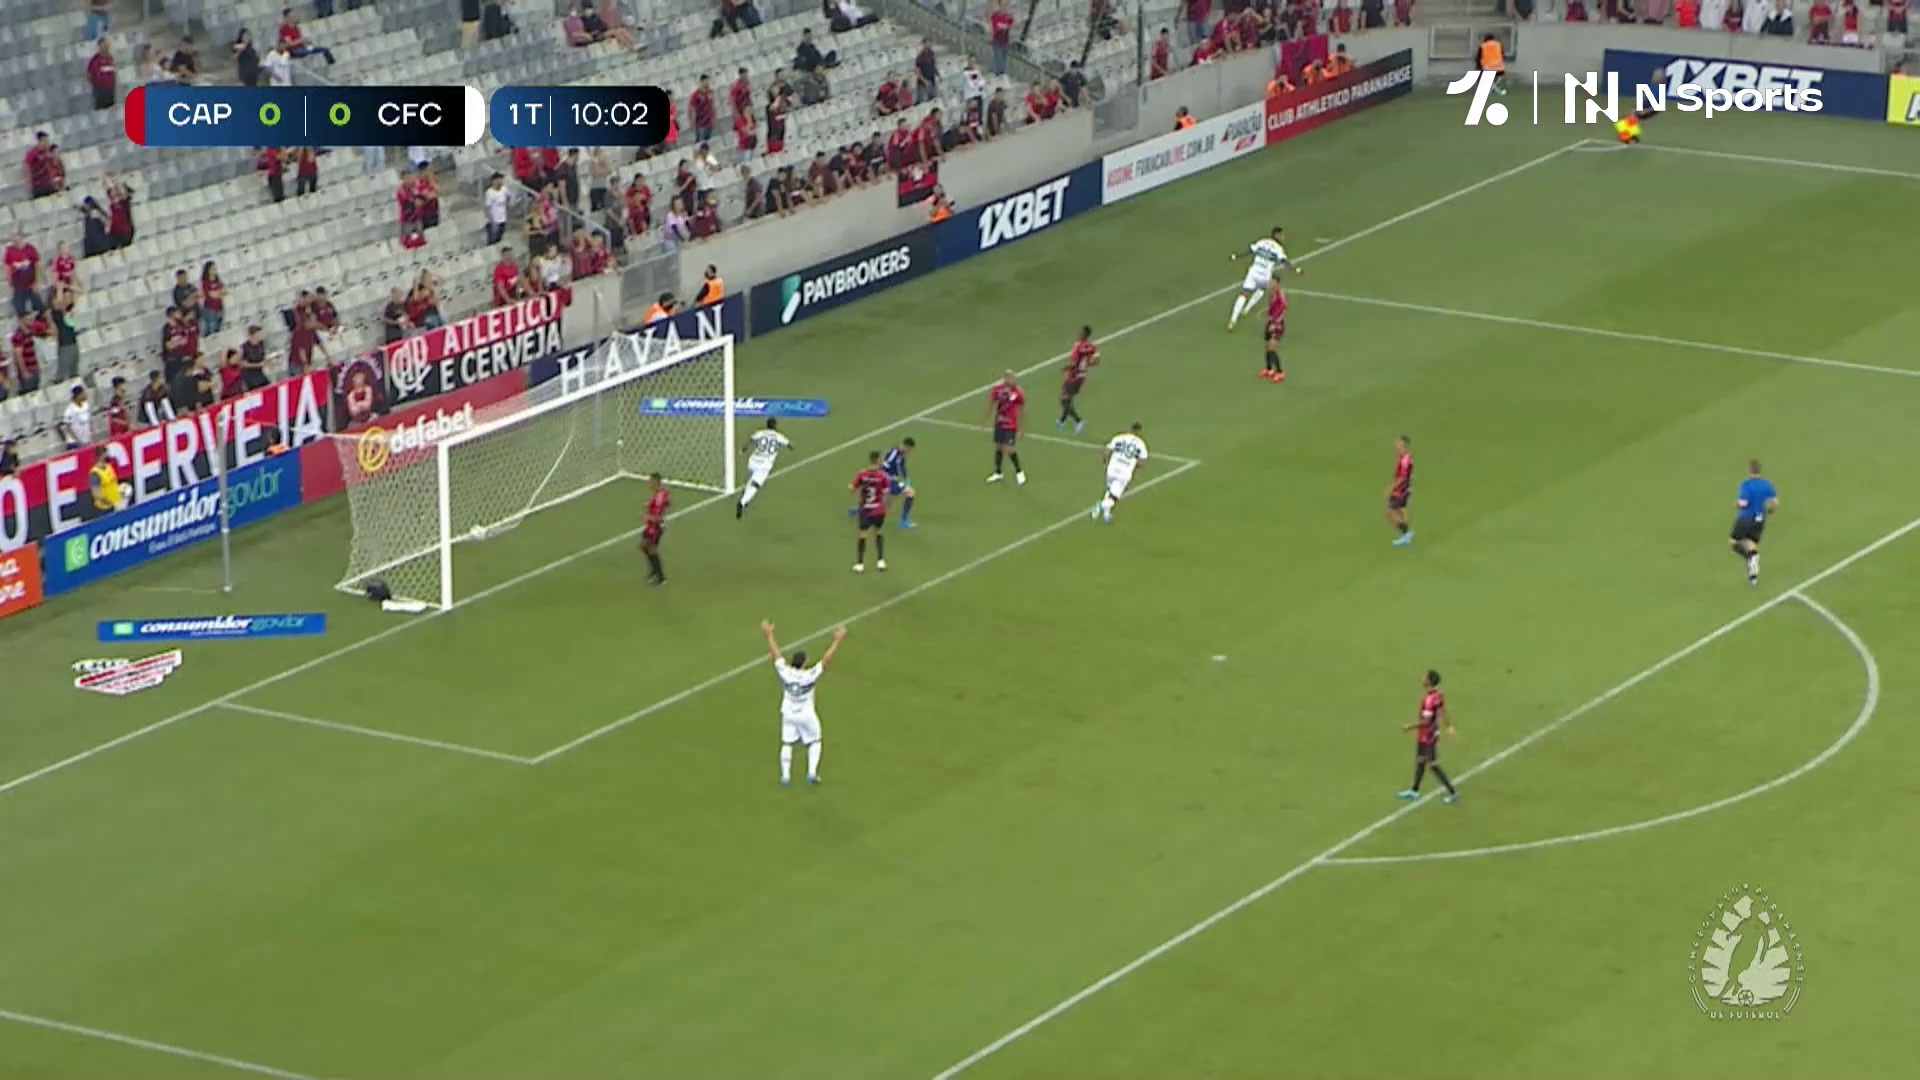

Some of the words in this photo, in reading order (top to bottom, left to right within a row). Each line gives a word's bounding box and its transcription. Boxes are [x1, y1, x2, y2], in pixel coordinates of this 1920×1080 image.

[1268, 108, 1294, 131] CLUB
[1295, 88, 1350, 120] ATHLETICO
[1351, 65, 1412, 101] PARANAENSE
[978, 176, 1071, 250] 1XBET
[802, 246, 911, 306] PAYBROKERS
[440, 358, 456, 391] E
[460, 321, 562, 384] CERVEJA
[557, 303, 723, 394] HAVAN
[391, 402, 473, 453] dafabet
[46, 455, 82, 533] E
